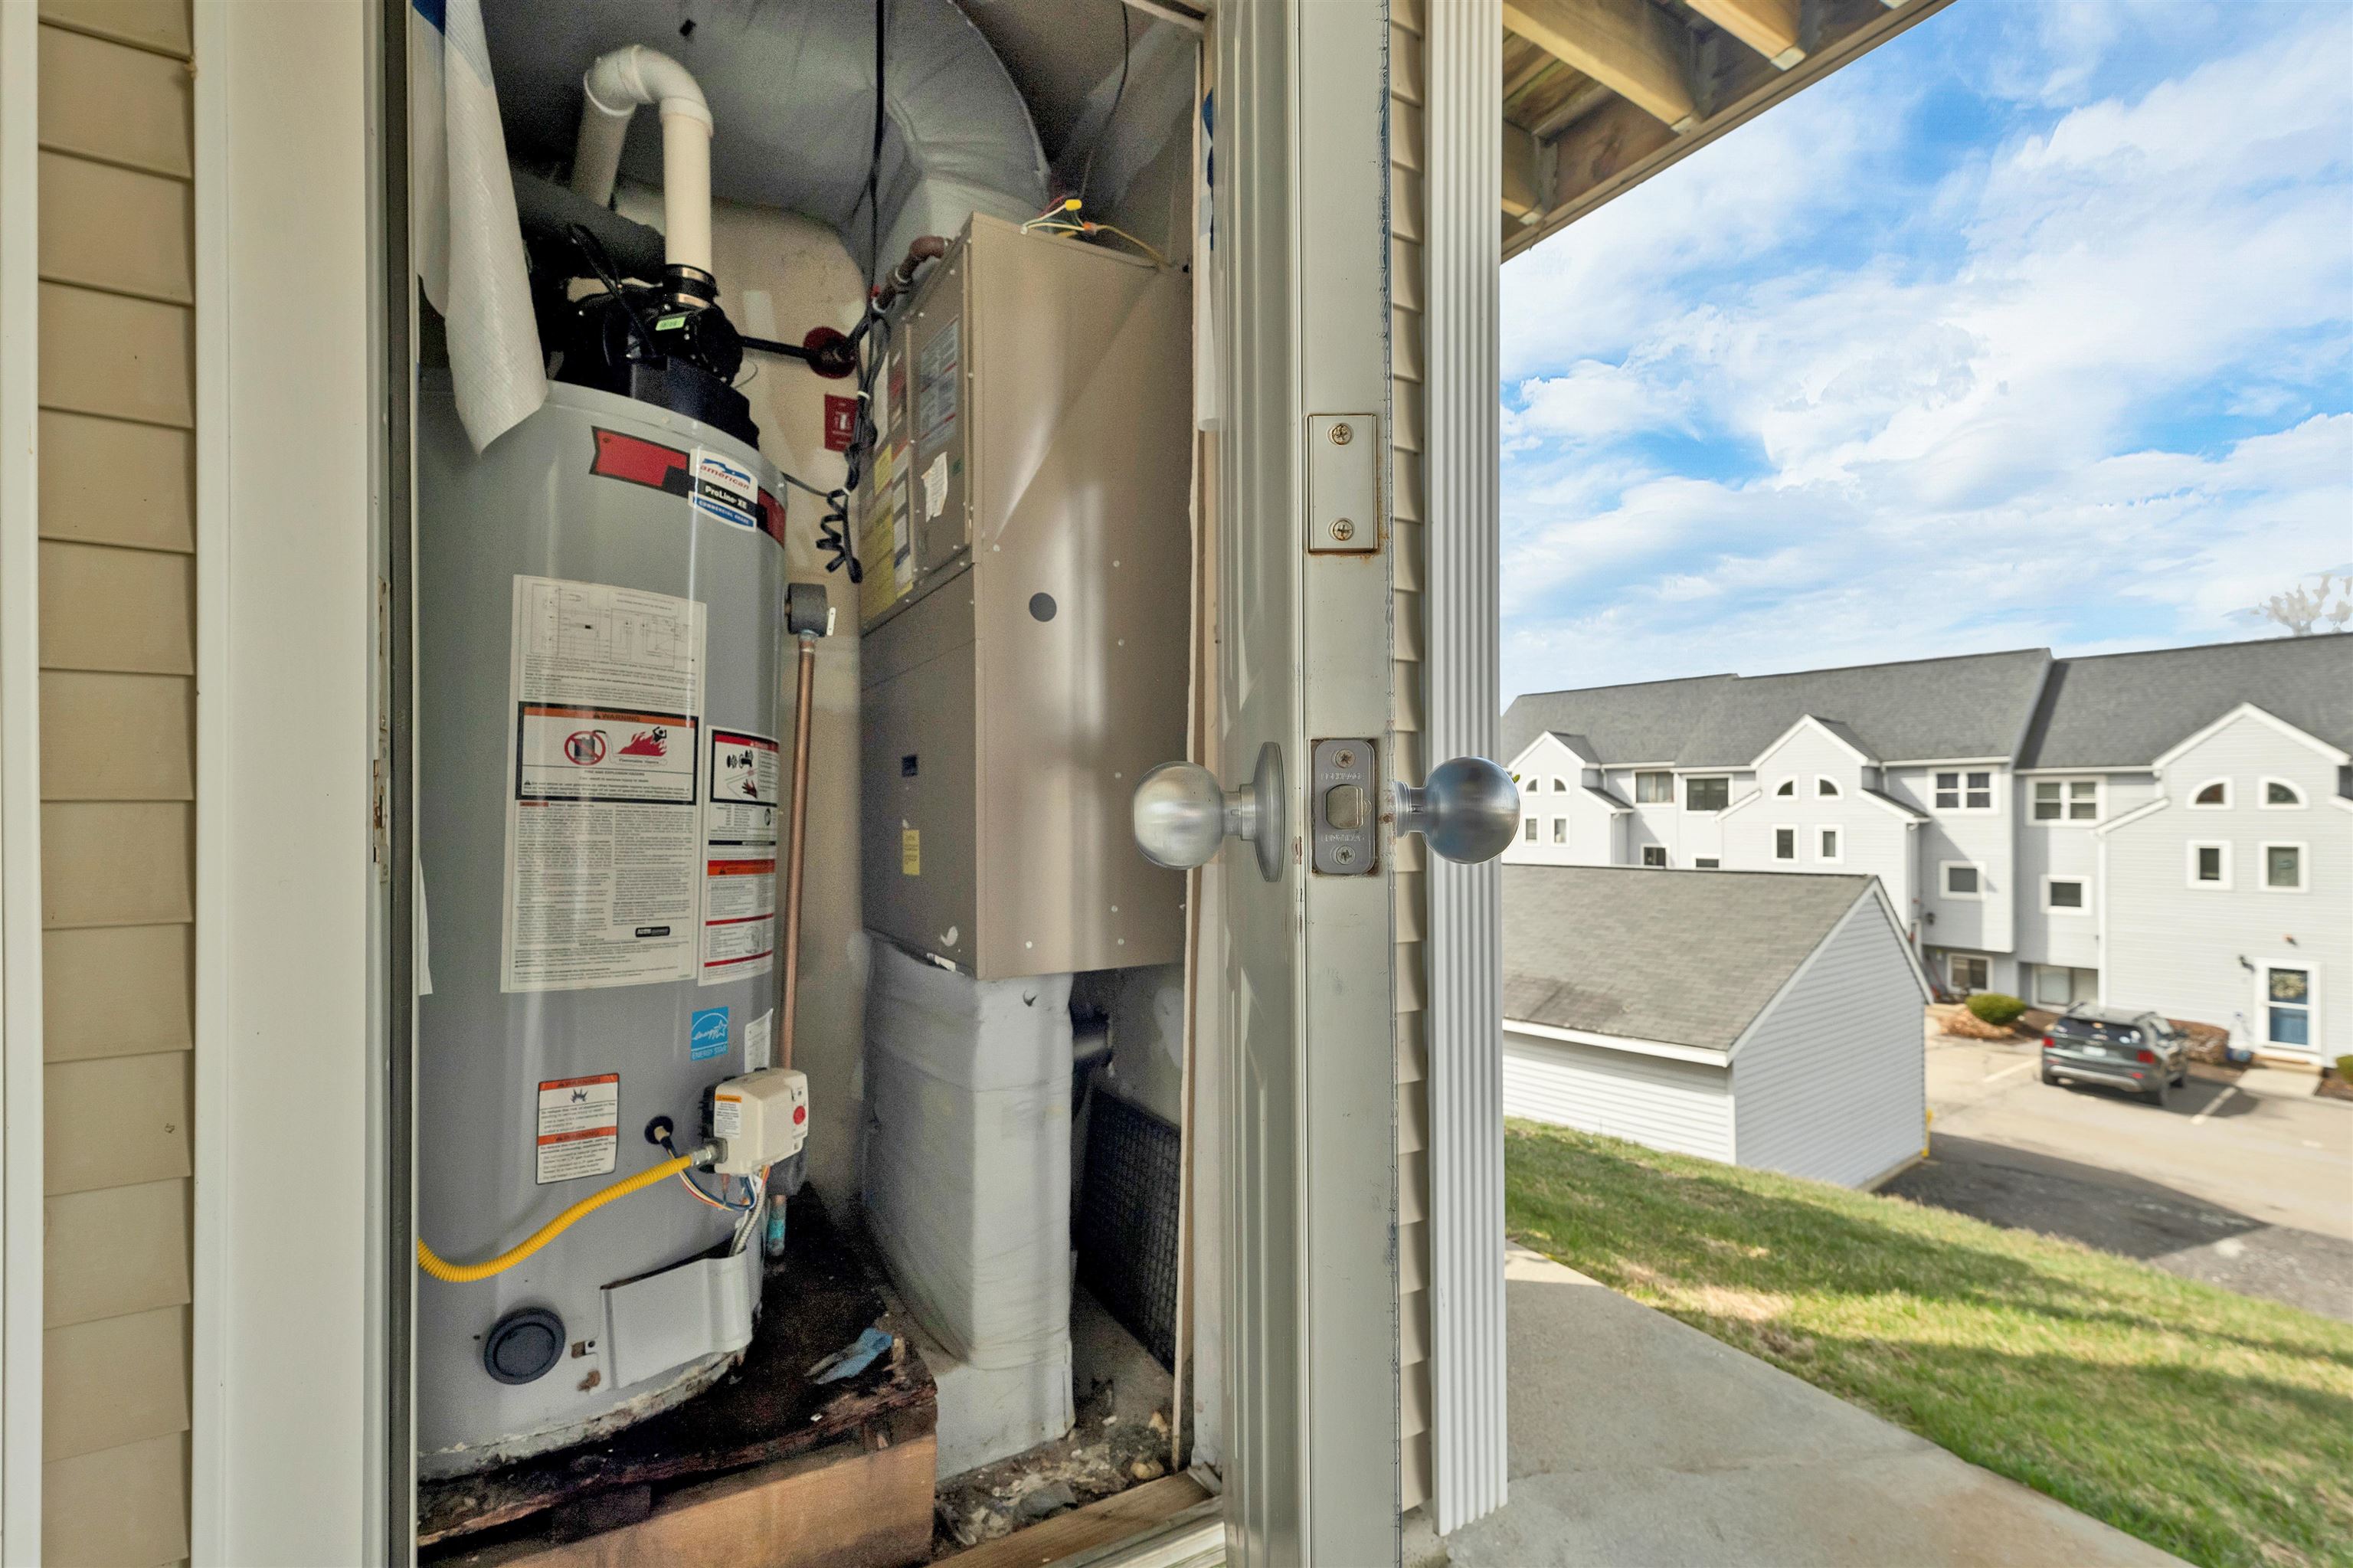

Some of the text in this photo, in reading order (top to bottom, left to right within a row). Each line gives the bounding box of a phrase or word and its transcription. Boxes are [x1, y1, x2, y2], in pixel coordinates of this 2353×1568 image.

[701, 465, 749, 489] american
[705, 485, 748, 509] ProLine XE
[602, 713, 640, 722] WARNING
